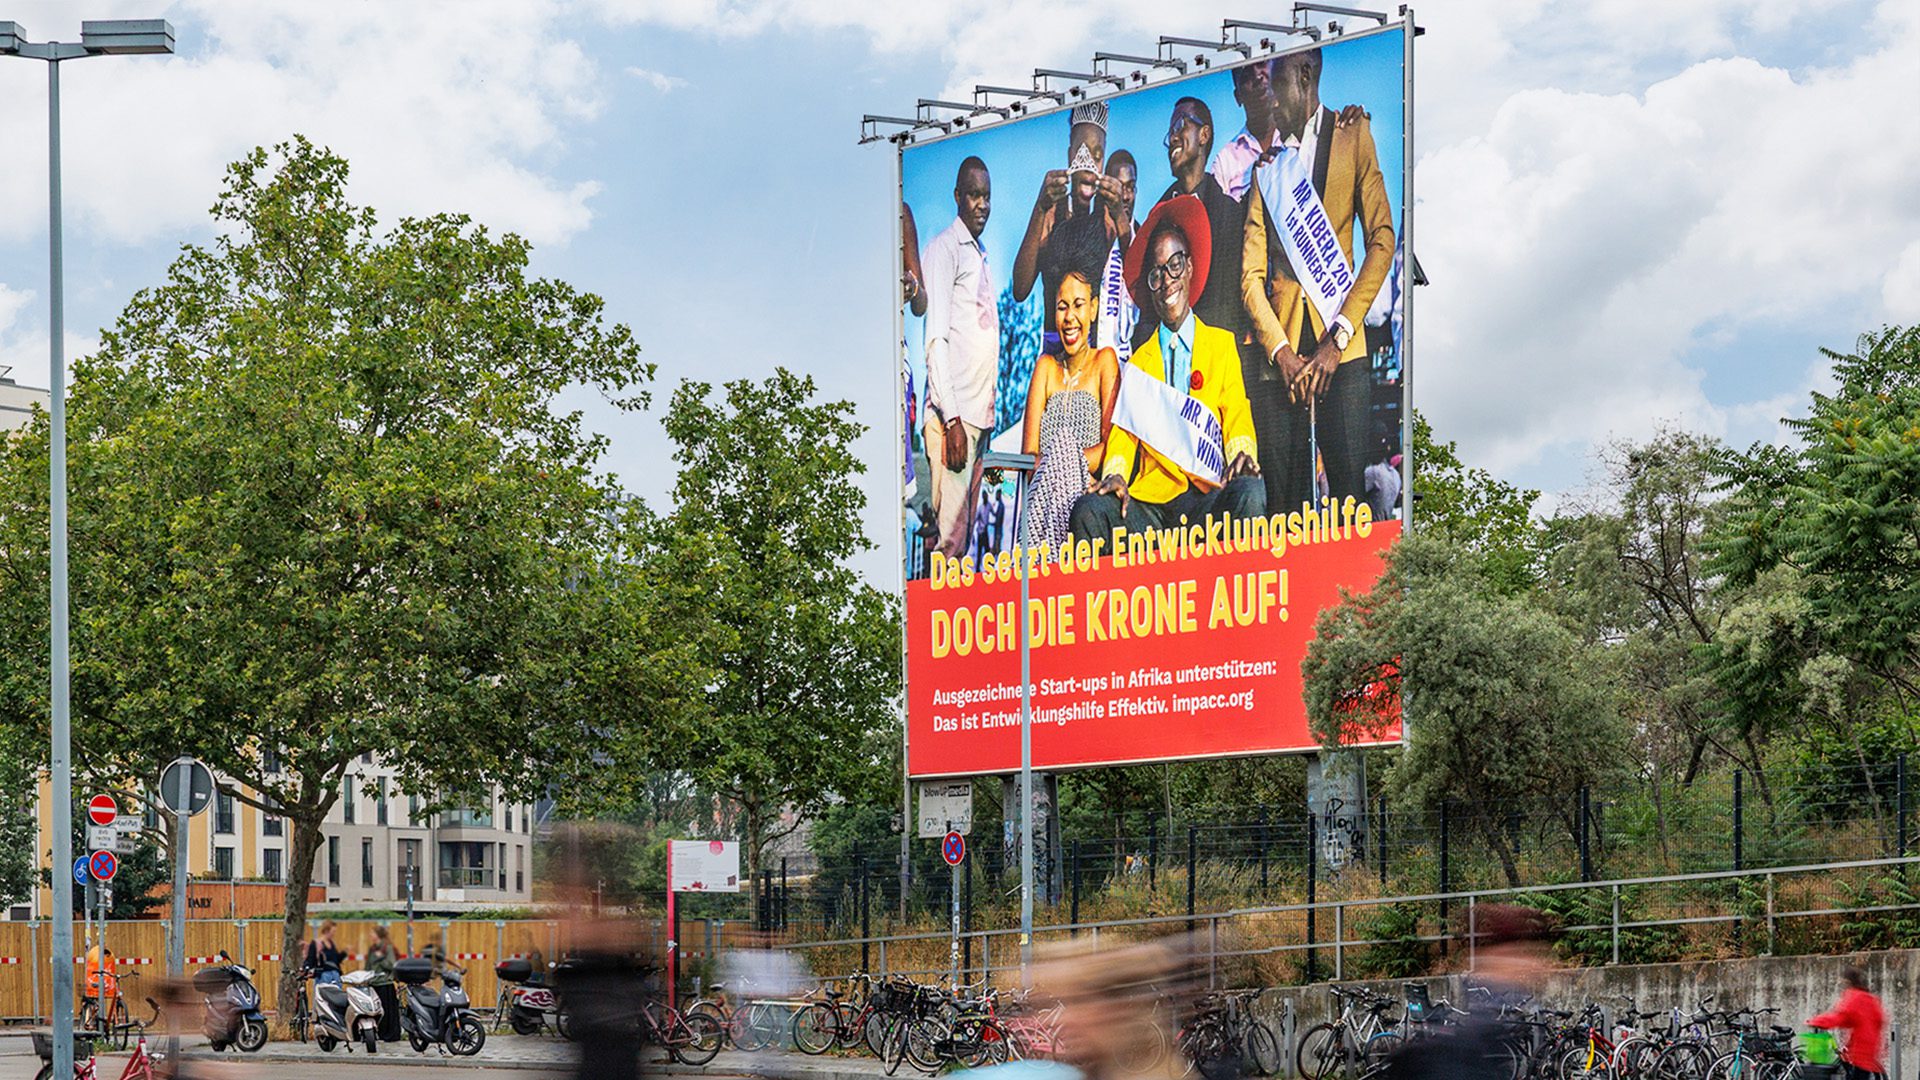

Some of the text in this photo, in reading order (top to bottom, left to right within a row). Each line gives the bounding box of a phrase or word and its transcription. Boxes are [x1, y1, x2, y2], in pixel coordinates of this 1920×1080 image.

[1284, 207, 1337, 299] 1st RUNNERS UP
[1292, 178, 1312, 213] MR.
[1304, 204, 1339, 268] KIBERA
[1106, 249, 1122, 317] WINNER
[1180, 397, 1202, 428] MR.
[930, 494, 1373, 590] Das setzt der Entwicklungshilfe
[931, 569, 1290, 658] DOCH DIE KRONE AUF!
[932, 660, 1277, 708] Ausgezeichnee Start-ups in Afrika unterstützen:
[933, 688, 1254, 732] Das ist Entwiklungshilfe Effektiv. impacc.org
